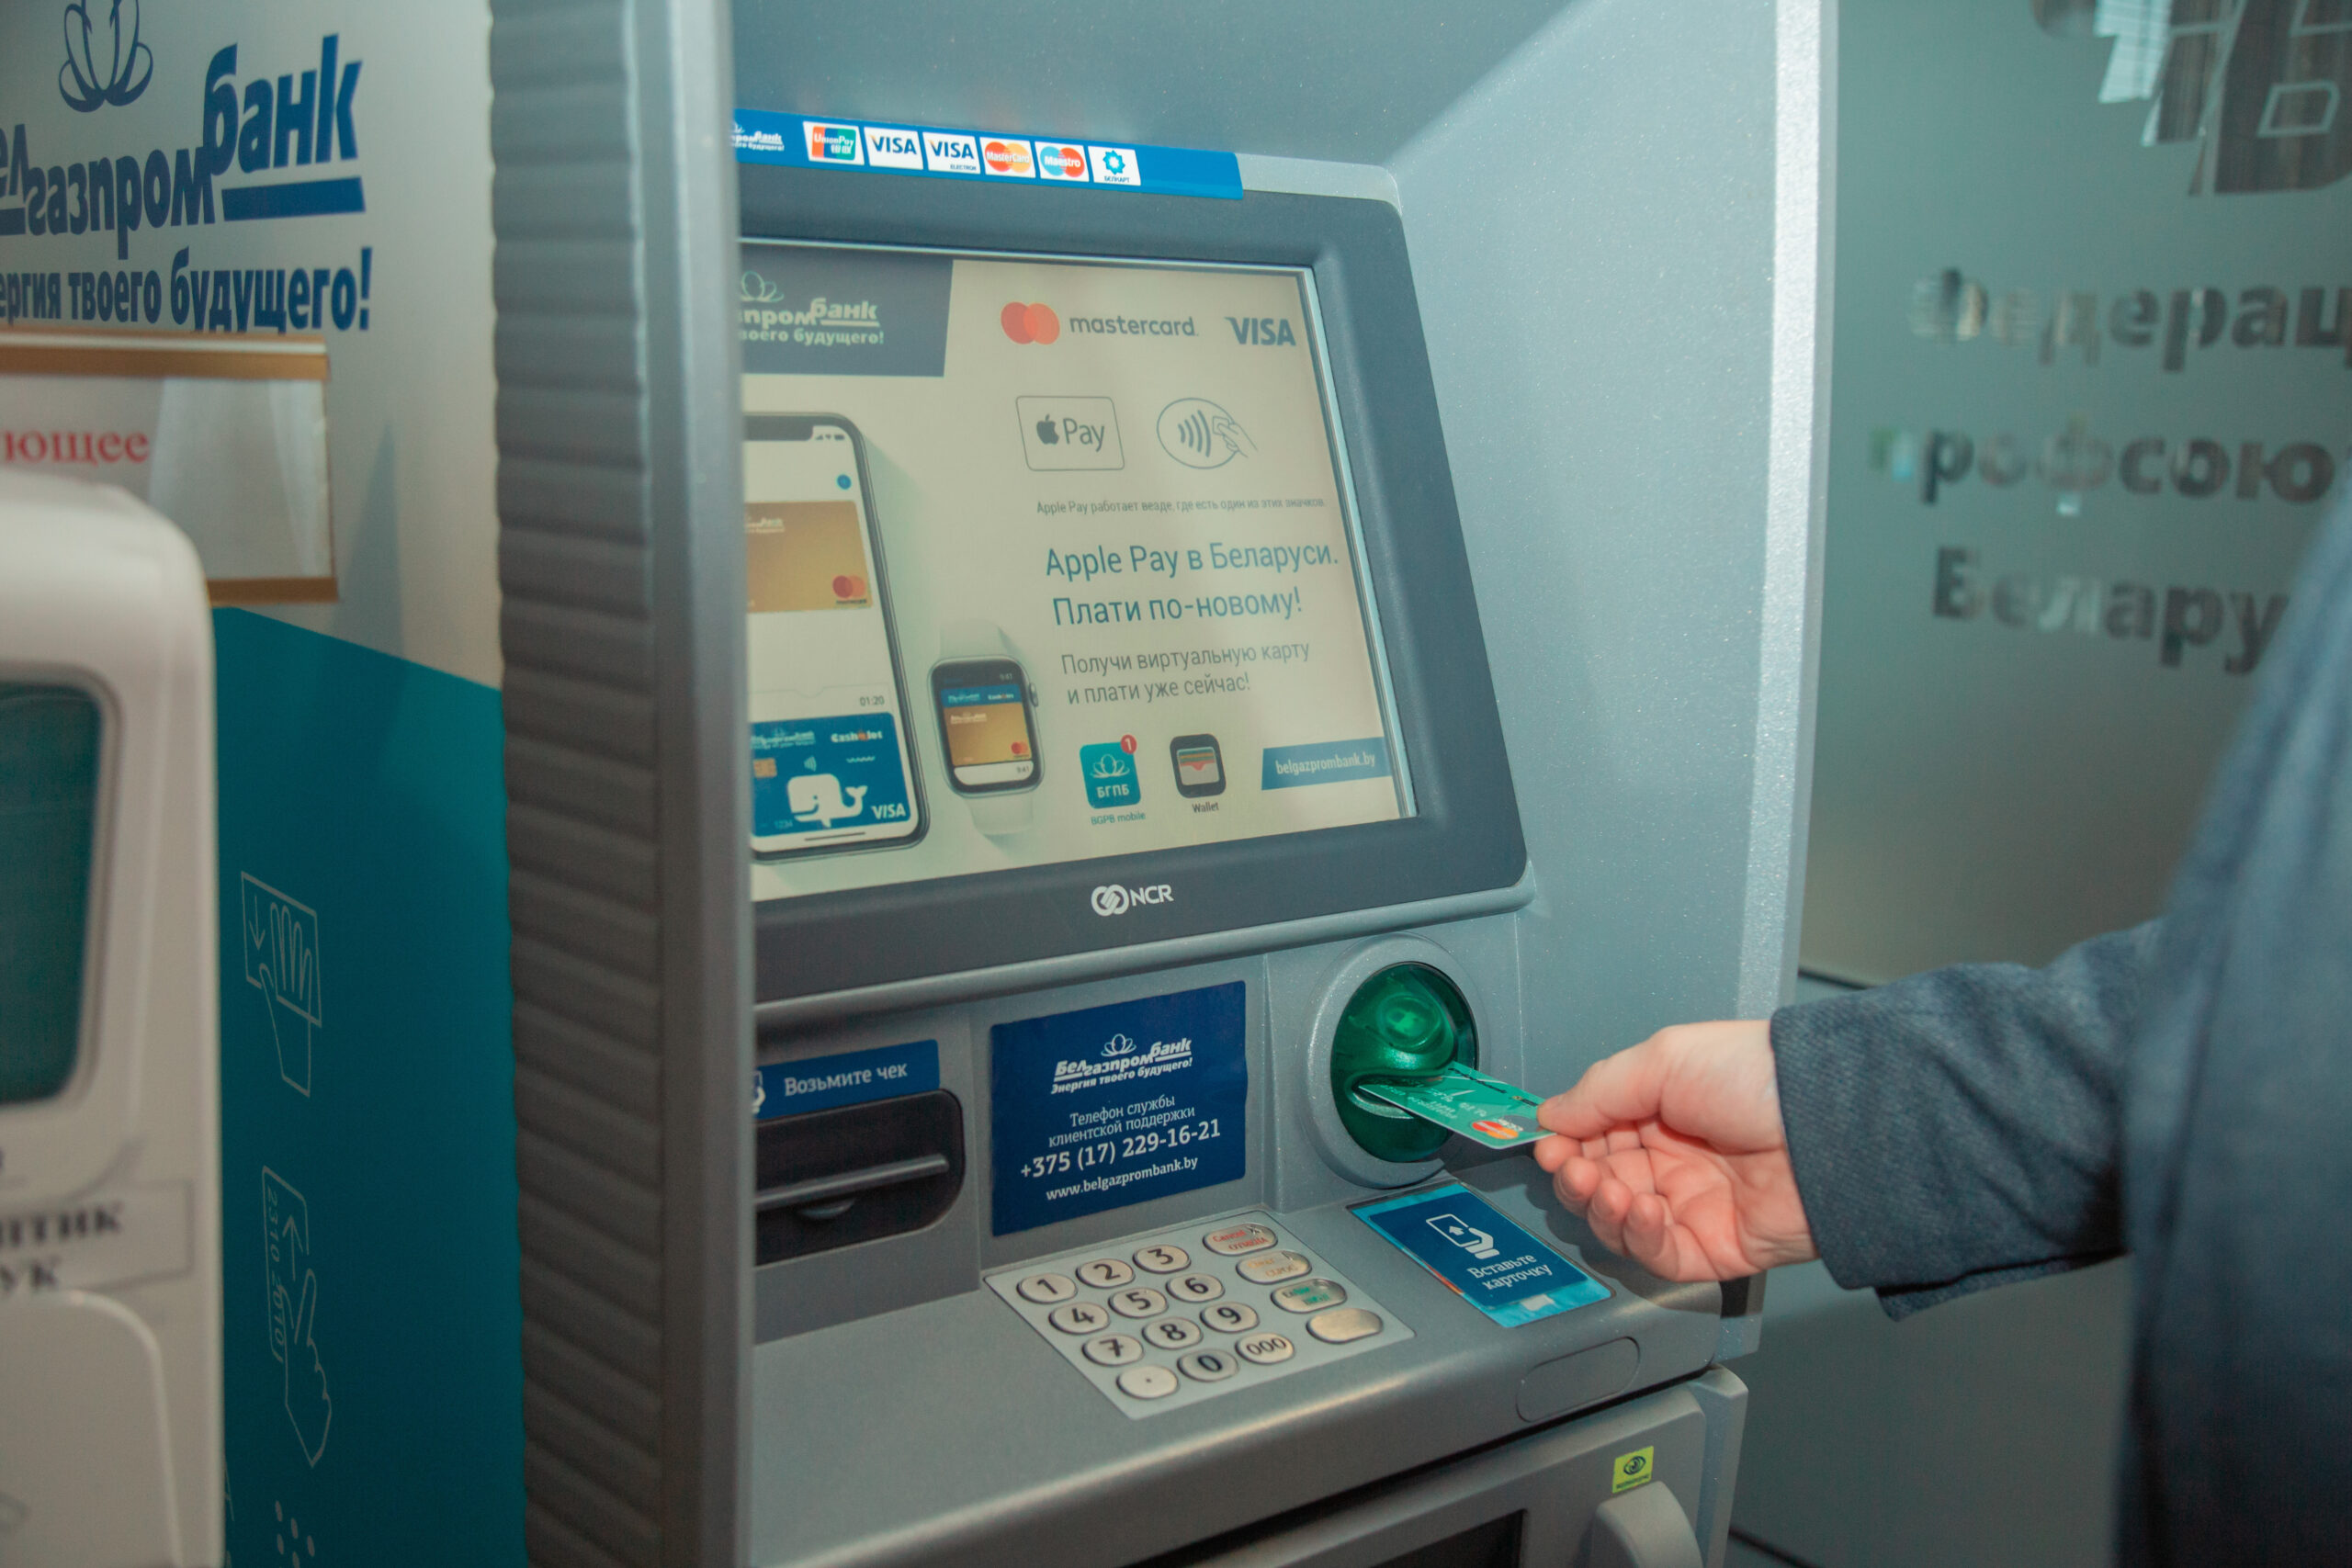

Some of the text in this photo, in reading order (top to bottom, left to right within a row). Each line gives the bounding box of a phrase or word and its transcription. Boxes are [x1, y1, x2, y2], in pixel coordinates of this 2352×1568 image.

[814, 132, 854, 147] UnionPay
[870, 135, 917, 154] VISA
[929, 140, 974, 159] VISA
[986, 152, 1030, 164] MasterCard
[1044, 155, 1081, 167] Maestro
[68, 270, 162, 323] твоего
[172, 246, 372, 334] будущего!
[794, 328, 884, 346] будущего!
[1225, 317, 1296, 346] VISA
[1063, 417, 1104, 452] Pay
[1037, 501, 1066, 515] Apple
[1069, 501, 1087, 514] Pay
[1091, 500, 1138, 514] работает
[1177, 501, 1193, 512] где
[1195, 500, 1218, 510] есть
[1221, 500, 1245, 512] один
[1261, 498, 1283, 508] этих
[1046, 542, 1338, 581] Apple Pay в Беларуси.
[1053, 586, 1302, 626] Плати по-новому!
[1061, 643, 1310, 676] Получи виртуальную карту
[1068, 671, 1250, 705] и плати уже сейчас!
[1274, 751, 1375, 775] belgazprombank.by
[1096, 784, 1130, 798] БГПБ
[871, 803, 907, 819] VISA
[1192, 802, 1219, 813] Wallet
[1091, 812, 1146, 825] BGPB mobile
[1130, 884, 1174, 907] NCR
[1055, 1037, 1192, 1079] Белгазпромбанк
[784, 1063, 908, 1097] Возьмите чек
[1051, 1057, 1193, 1095] Энергия твоего будущего!
[1069, 1094, 1176, 1127] Телефон службы
[1048, 1106, 1195, 1147] клиентской поддержки
[1021, 1118, 1221, 1178] +375 (17) 229-16-21
[1046, 1156, 1198, 1201] www.belgazprombank.by
[1147, 1248, 1174, 1265] 3
[1093, 1263, 1121, 1280] 2
[1466, 1255, 1537, 1279] Вставьте
[1482, 1264, 1553, 1290] карточку
[1036, 1278, 1058, 1295] 1
[1184, 1277, 1210, 1294] 6
[1125, 1291, 1152, 1311] 5
[1071, 1307, 1095, 1325] 4
[1216, 1306, 1241, 1325] 9
[1159, 1323, 1187, 1341] 8
[1099, 1337, 1125, 1358] 7
[1197, 1354, 1223, 1372] 0
